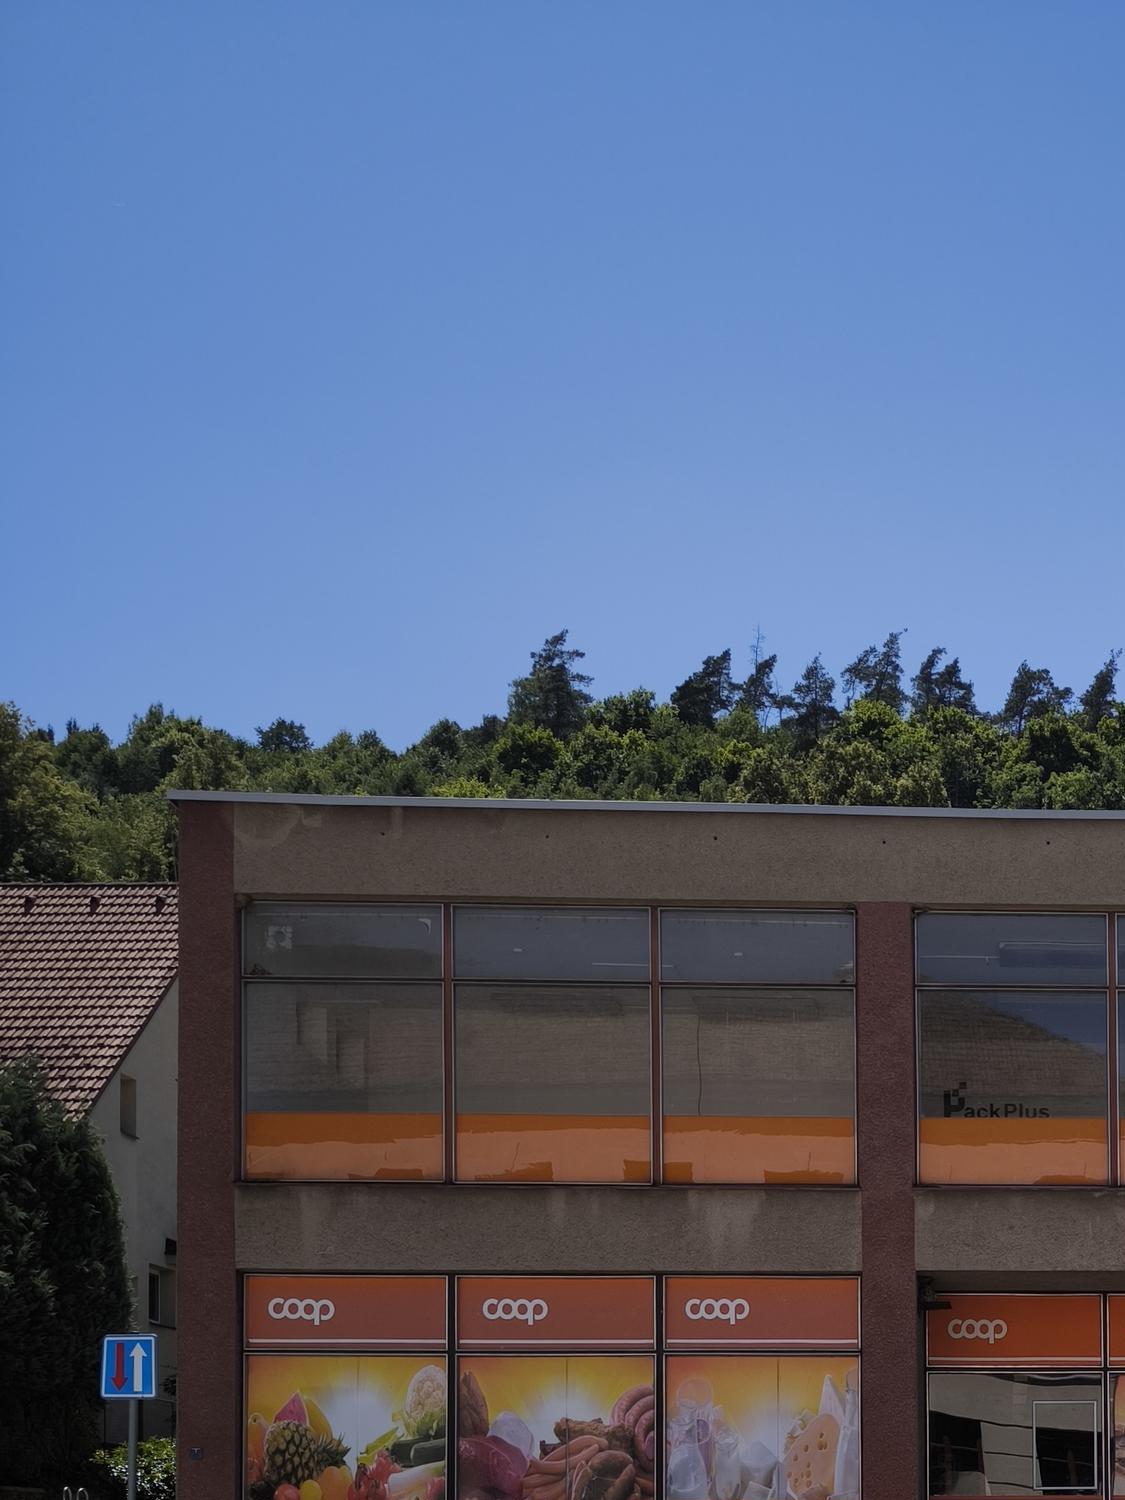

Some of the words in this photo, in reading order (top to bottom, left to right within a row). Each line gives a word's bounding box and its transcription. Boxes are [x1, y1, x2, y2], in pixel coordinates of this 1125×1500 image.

[267, 1297, 336, 1326] coop
[482, 1298, 549, 1326] coop
[685, 1298, 750, 1325] coop
[947, 1318, 1008, 1344] coop
